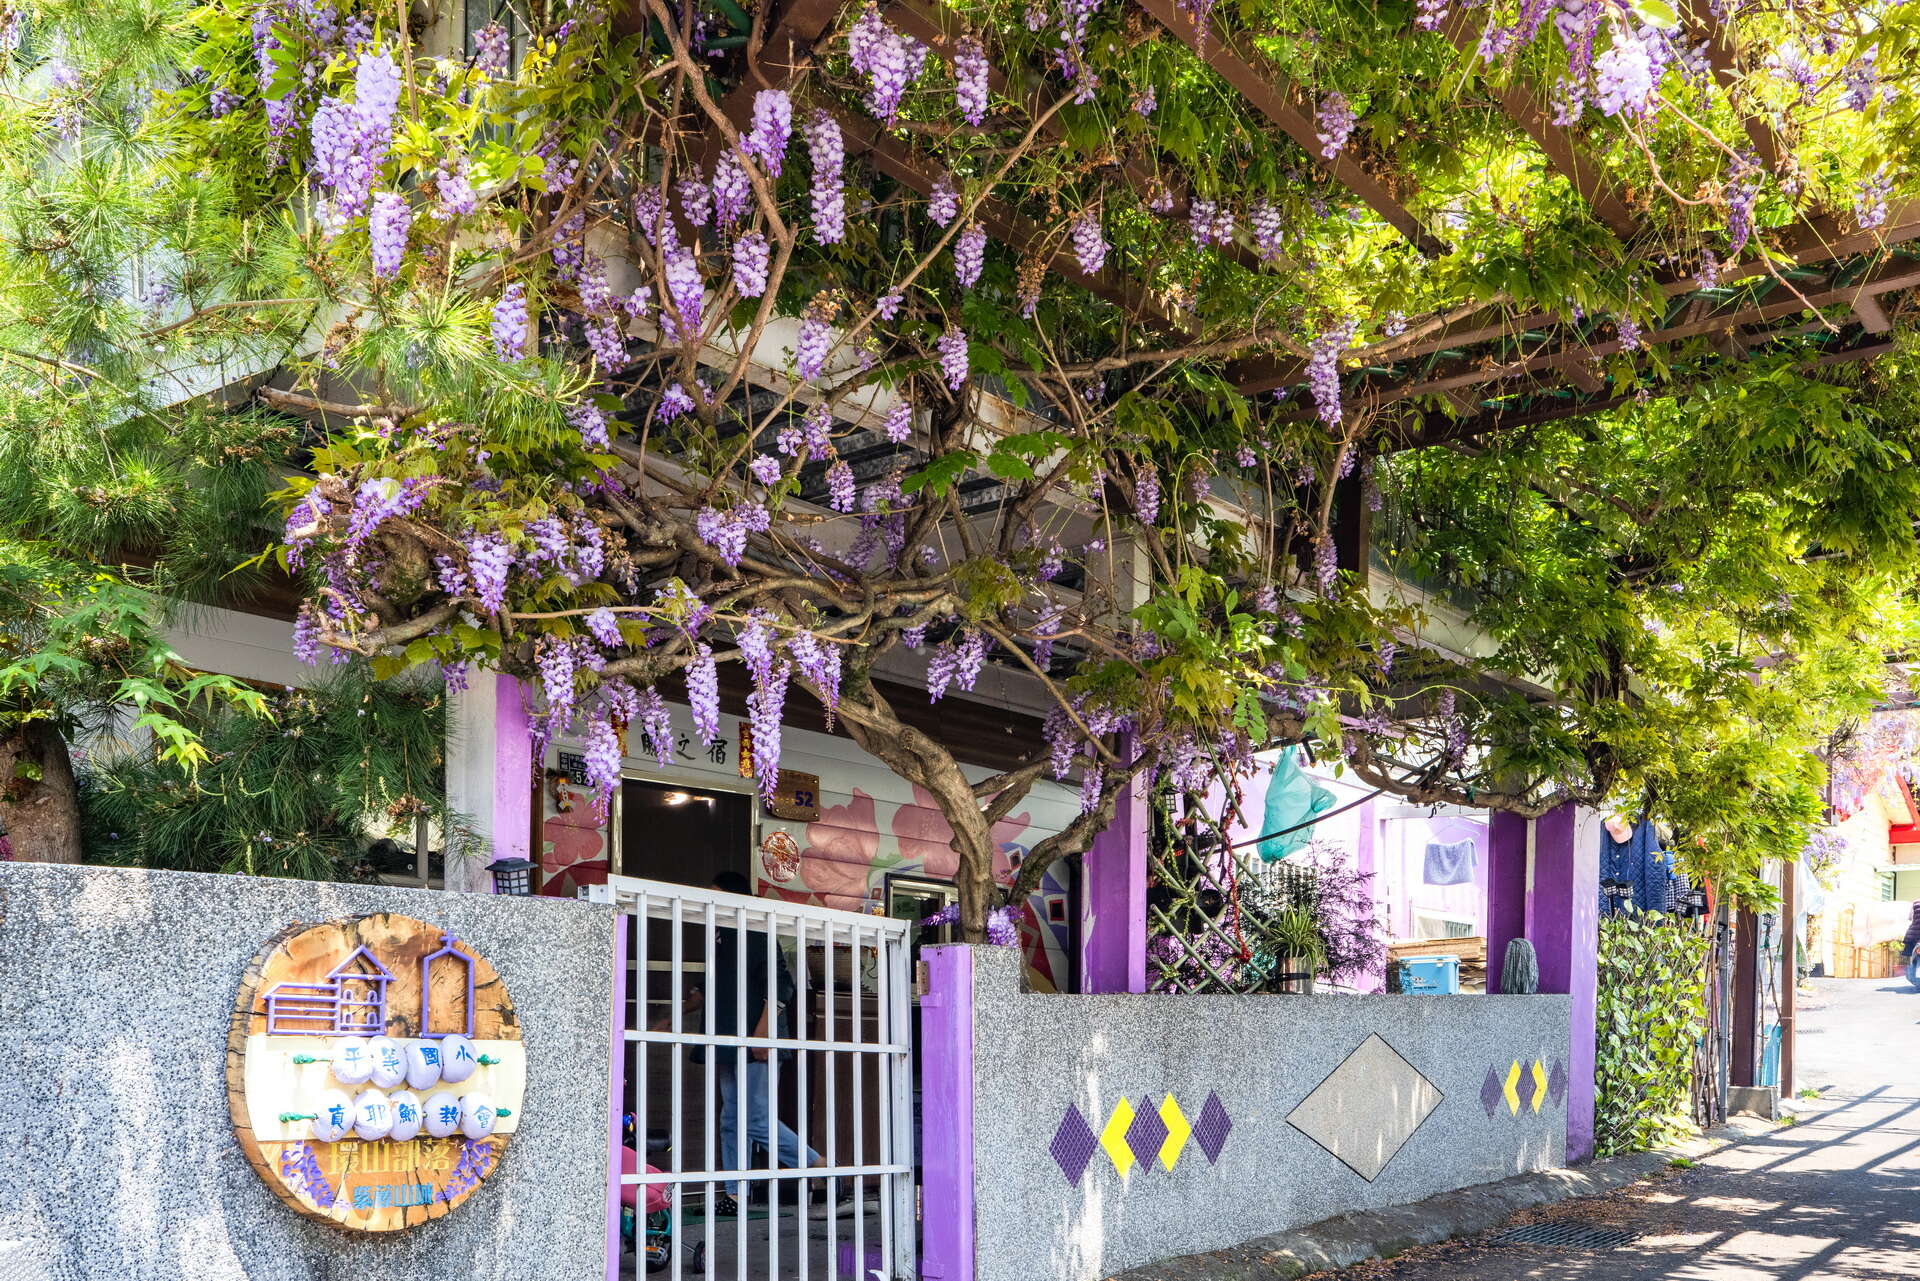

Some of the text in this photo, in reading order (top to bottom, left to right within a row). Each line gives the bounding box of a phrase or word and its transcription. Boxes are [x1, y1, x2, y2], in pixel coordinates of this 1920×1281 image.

[795, 790, 814, 808] 52
[344, 1044, 477, 1075] 平等國小
[328, 1138, 450, 1174] 環山部落
